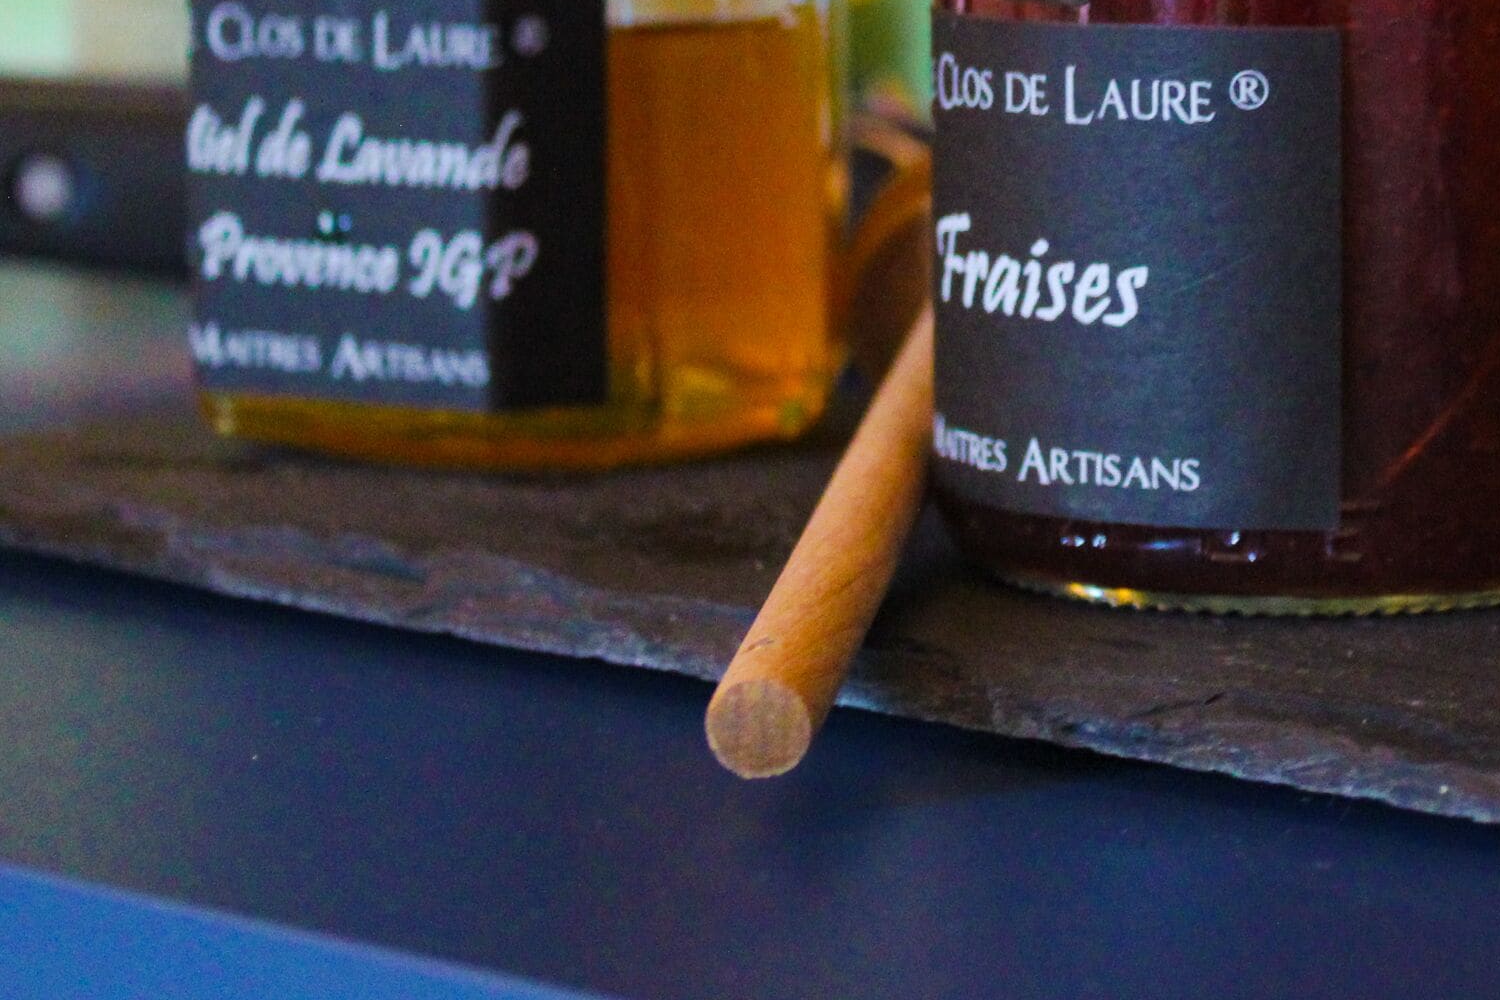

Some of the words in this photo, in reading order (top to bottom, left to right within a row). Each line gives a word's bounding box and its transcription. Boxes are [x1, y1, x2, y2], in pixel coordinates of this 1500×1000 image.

[1006, 72, 1051, 117] DE
[1065, 66, 1217, 127] LAURE
[256, 97, 312, 180] de
[316, 113, 527, 192] Lavande
[200, 212, 400, 294] Provence
[408, 228, 536, 310] IGP
[937, 213, 1150, 328] Fraises
[1018, 438, 1201, 493] ARTISANS
